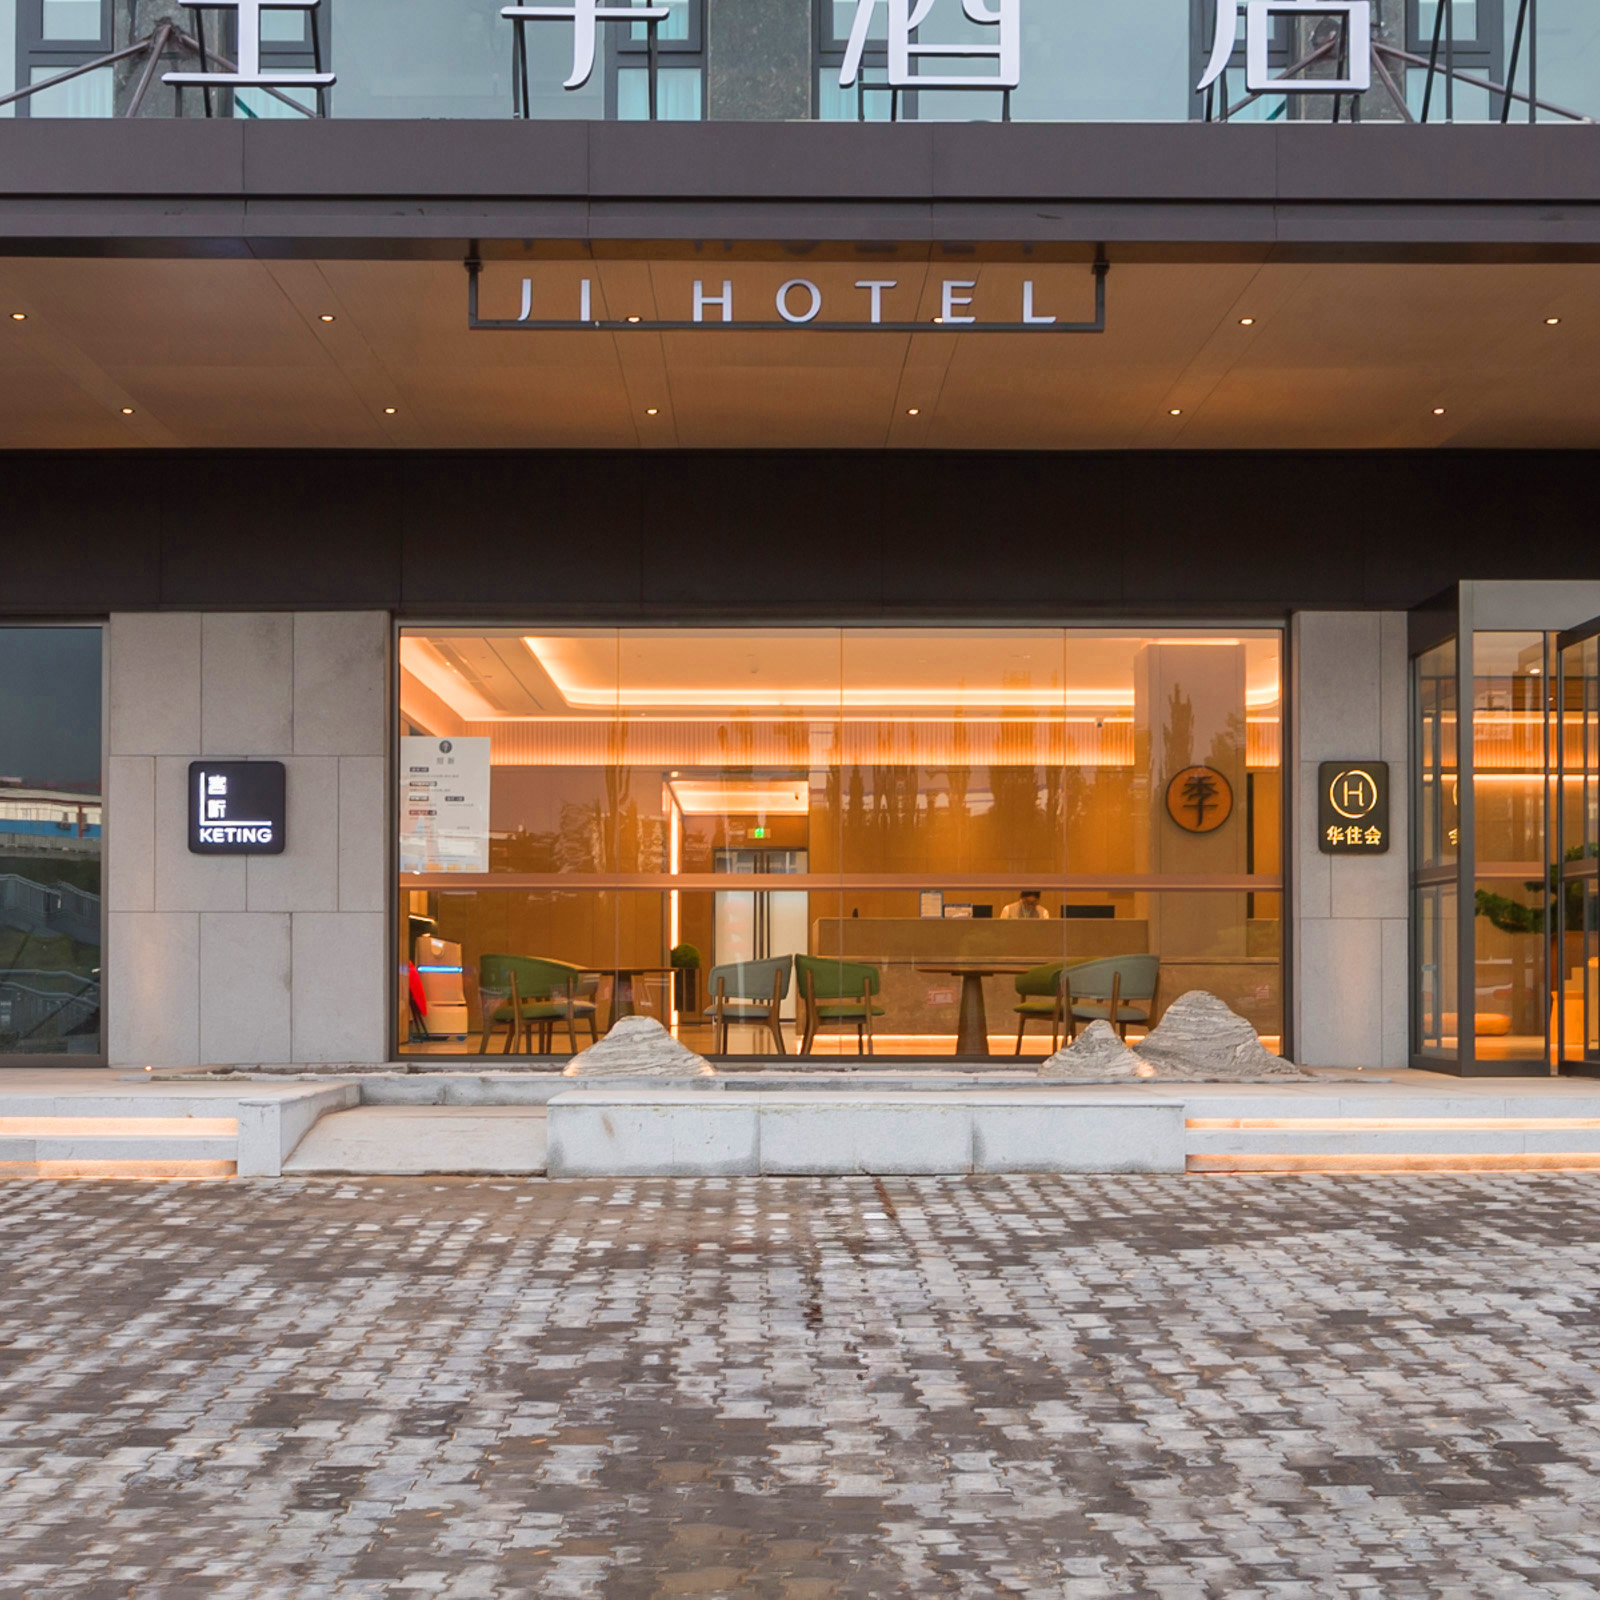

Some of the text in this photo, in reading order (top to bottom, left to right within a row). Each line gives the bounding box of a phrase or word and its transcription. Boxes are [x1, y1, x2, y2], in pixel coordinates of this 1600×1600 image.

[517, 278, 1057, 324] JI HOTEL
[1181, 775, 1221, 828] 季
[199, 827, 273, 844] KETING
[1326, 824, 1382, 846] 华住会
